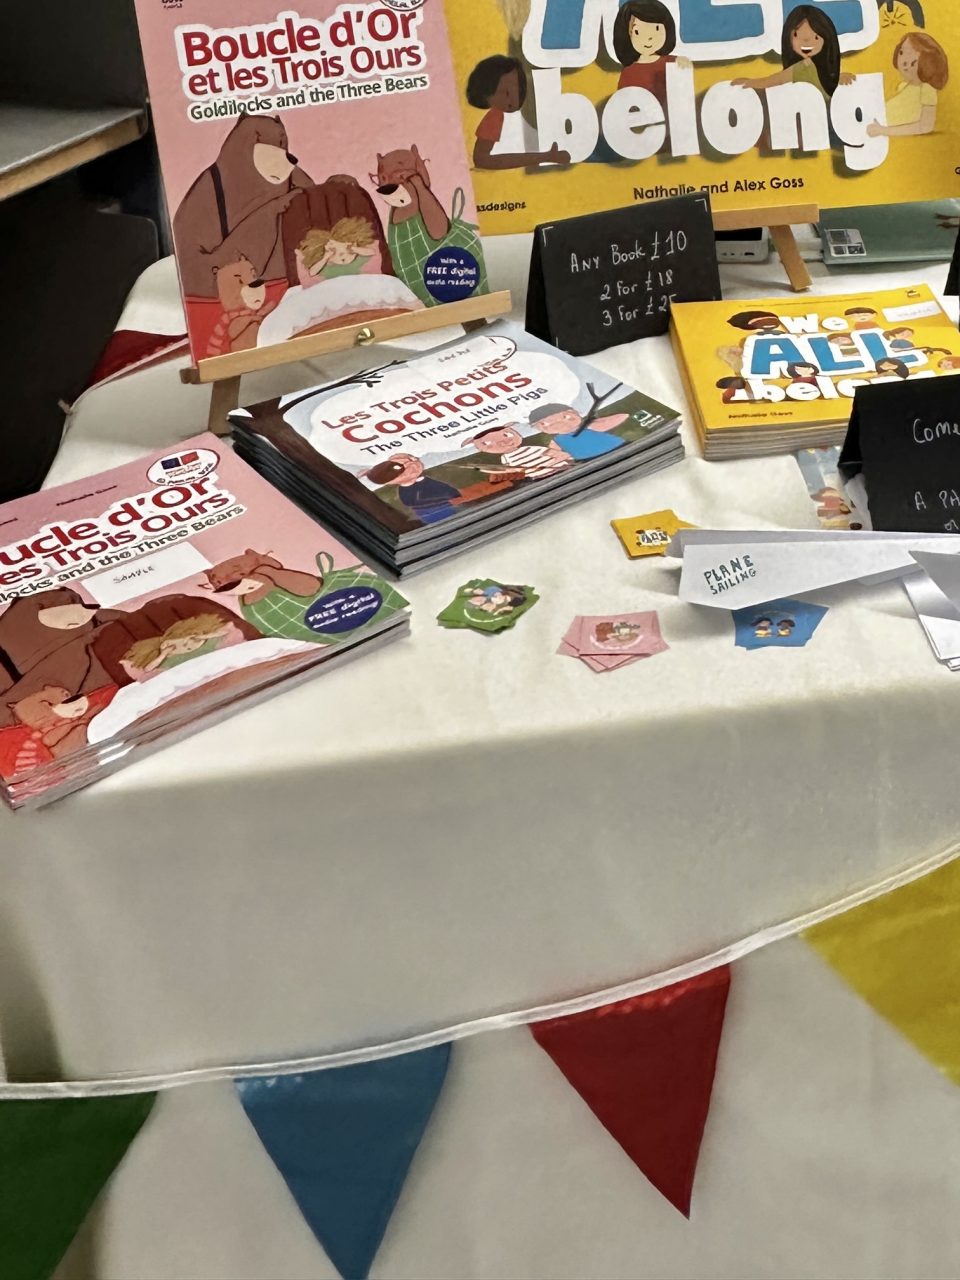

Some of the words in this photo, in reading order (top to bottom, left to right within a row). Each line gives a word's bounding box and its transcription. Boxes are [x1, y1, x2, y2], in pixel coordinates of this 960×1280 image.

[182, 17, 321, 67] Boucle
[329, 8, 417, 48] d'Or
[188, 67, 222, 96] et
[224, 62, 270, 92] les
[272, 50, 345, 85] Trois
[350, 43, 422, 74] Ours
[190, 96, 273, 121] Goldilocks
[276, 89, 306, 108] and
[310, 86, 336, 103] the
[337, 80, 382, 100] Three
[385, 75, 429, 92] Bears
[530, 58, 890, 170] belong
[700, 181, 729, 194] and
[733, 179, 767, 192] Alex
[770, 176, 805, 190] Goss
[610, 239, 647, 265] Book
[600, 283, 612, 301] 2
[602, 309, 613, 327] 3
[778, 313, 850, 334] We
[749, 332, 919, 376] ALL
[322, 410, 372, 429] Les
[371, 388, 438, 414] Trois
[436, 358, 508, 393] Petits
[341, 369, 533, 444] Cochons
[360, 437, 402, 456] The
[402, 418, 461, 445] Three
[459, 402, 509, 427] Little
[511, 387, 549, 410] Pigs
[107, 476, 211, 527] d'Or
[914, 490, 927, 511] A
[42, 529, 138, 567] Trois
[140, 492, 230, 533] Ours
[57, 561, 97, 584] and
[97, 549, 133, 567] the
[133, 527, 190, 556] Three
[192, 506, 245, 533] Bears
[703, 554, 754, 585] PLANE
[709, 568, 757, 596] SAILING
